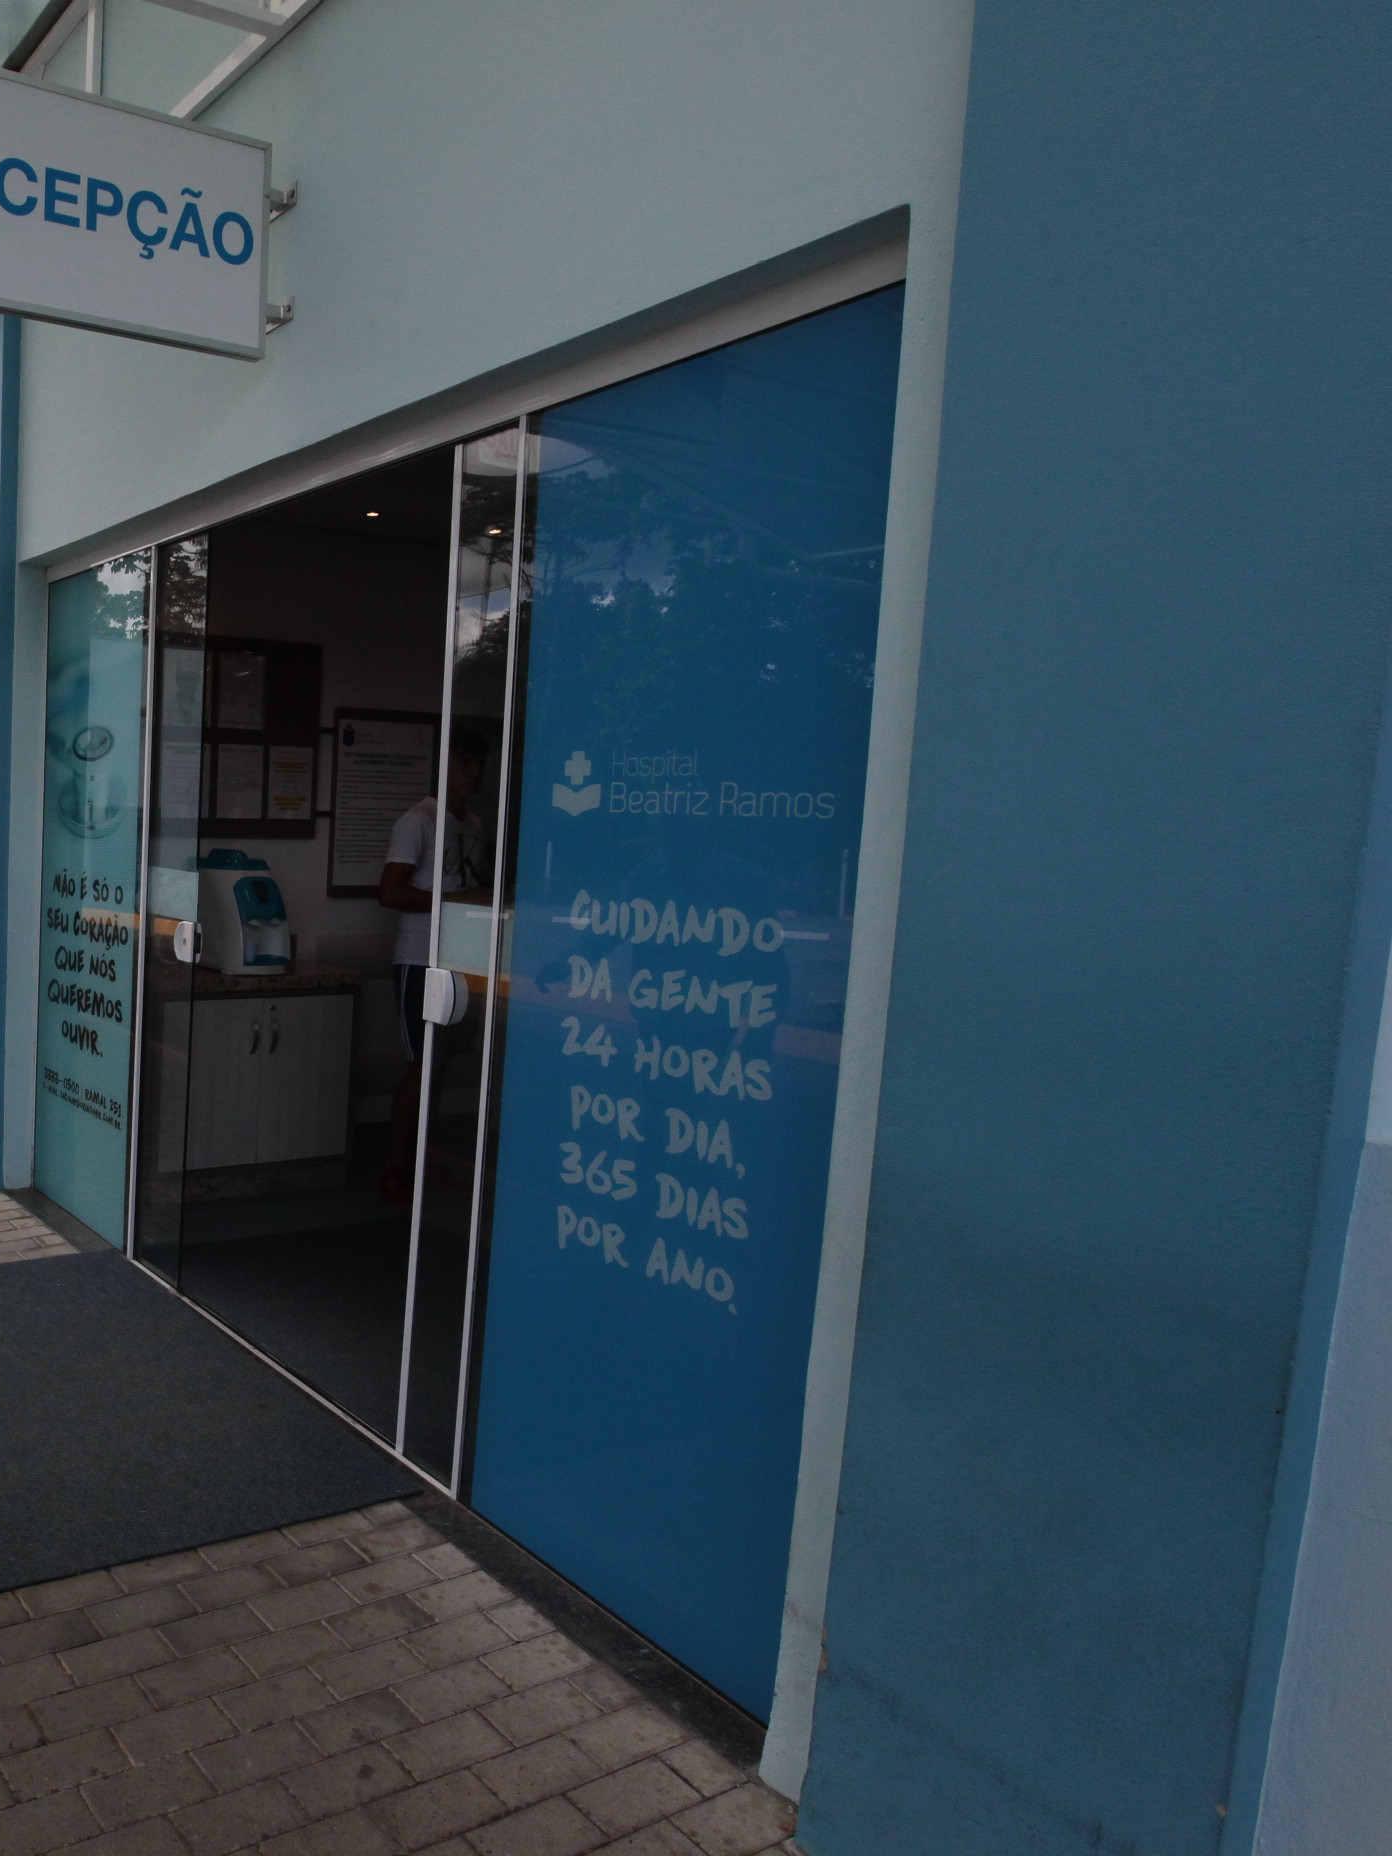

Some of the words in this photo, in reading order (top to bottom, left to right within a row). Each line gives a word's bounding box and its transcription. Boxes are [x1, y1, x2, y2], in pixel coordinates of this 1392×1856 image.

[611, 749, 699, 783] Hospital
[609, 781, 709, 815] Beatriz
[719, 781, 836, 819] Ramos
[53, 868, 76, 897] NÃO
[80, 872, 88, 899] É
[93, 878, 110, 903] SÓ
[114, 885, 124, 904] O
[47, 907, 69, 934] SEU
[73, 912, 129, 950] CORAÇÃO
[569, 888, 784, 956] CUIDANDO
[54, 945, 85, 973] QUE
[89, 951, 116, 982] NÓS
[47, 978, 123, 1023] QUEREMOS
[567, 956, 611, 1001] DA
[628, 968, 778, 1029] GENTE
[61, 1020, 104, 1058] OUVIR.
[561, 1016, 617, 1066] 24
[634, 1036, 772, 1101] HORAS
[84, 1088, 107, 1109] RAMAL
[571, 1085, 645, 1142] POR
[666, 1107, 746, 1179] DIA,
[561, 1142, 638, 1200] 365
[655, 1172, 749, 1239] DIAS
[556, 1205, 629, 1268] POR
